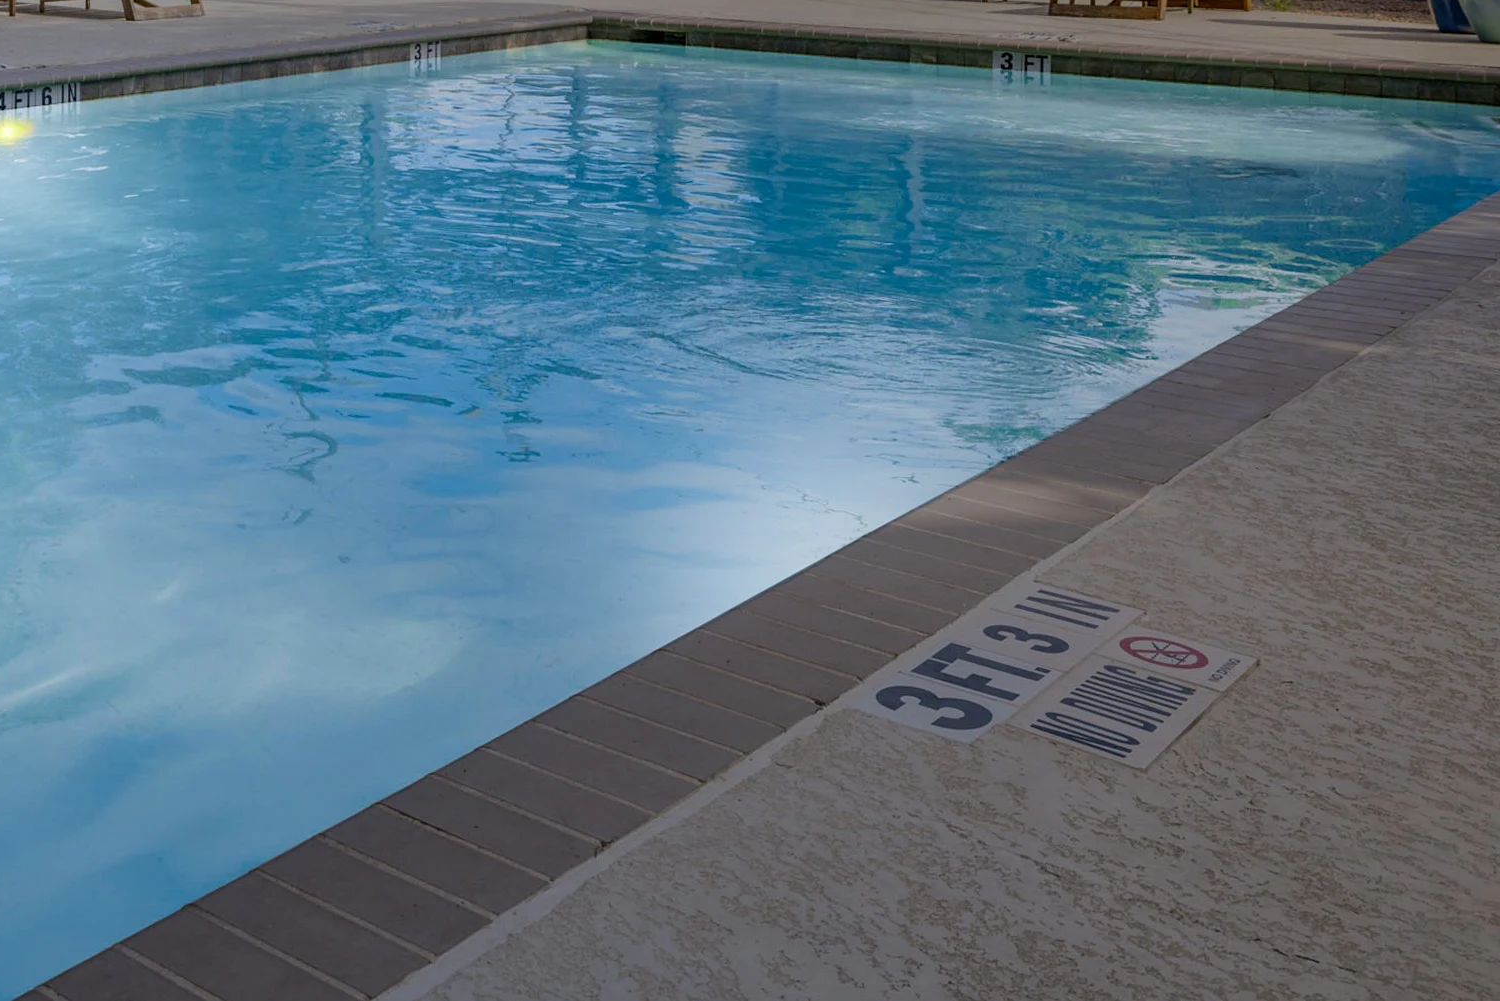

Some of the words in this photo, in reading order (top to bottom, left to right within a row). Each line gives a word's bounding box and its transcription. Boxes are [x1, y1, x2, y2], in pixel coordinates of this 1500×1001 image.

[414, 43, 422, 60] 3
[427, 41, 440, 59] FT
[1000, 52, 1014, 70] 3
[1024, 54, 1049, 73] FT
[14, 88, 34, 110] FT
[41, 86, 53, 106] 6
[61, 82, 78, 104] IN
[1014, 589, 1121, 630] IN
[983, 624, 1070, 654] 3
[876, 685, 993, 730] 3
[1059, 664, 1197, 733] DIVING
[1030, 711, 1141, 758] NO
